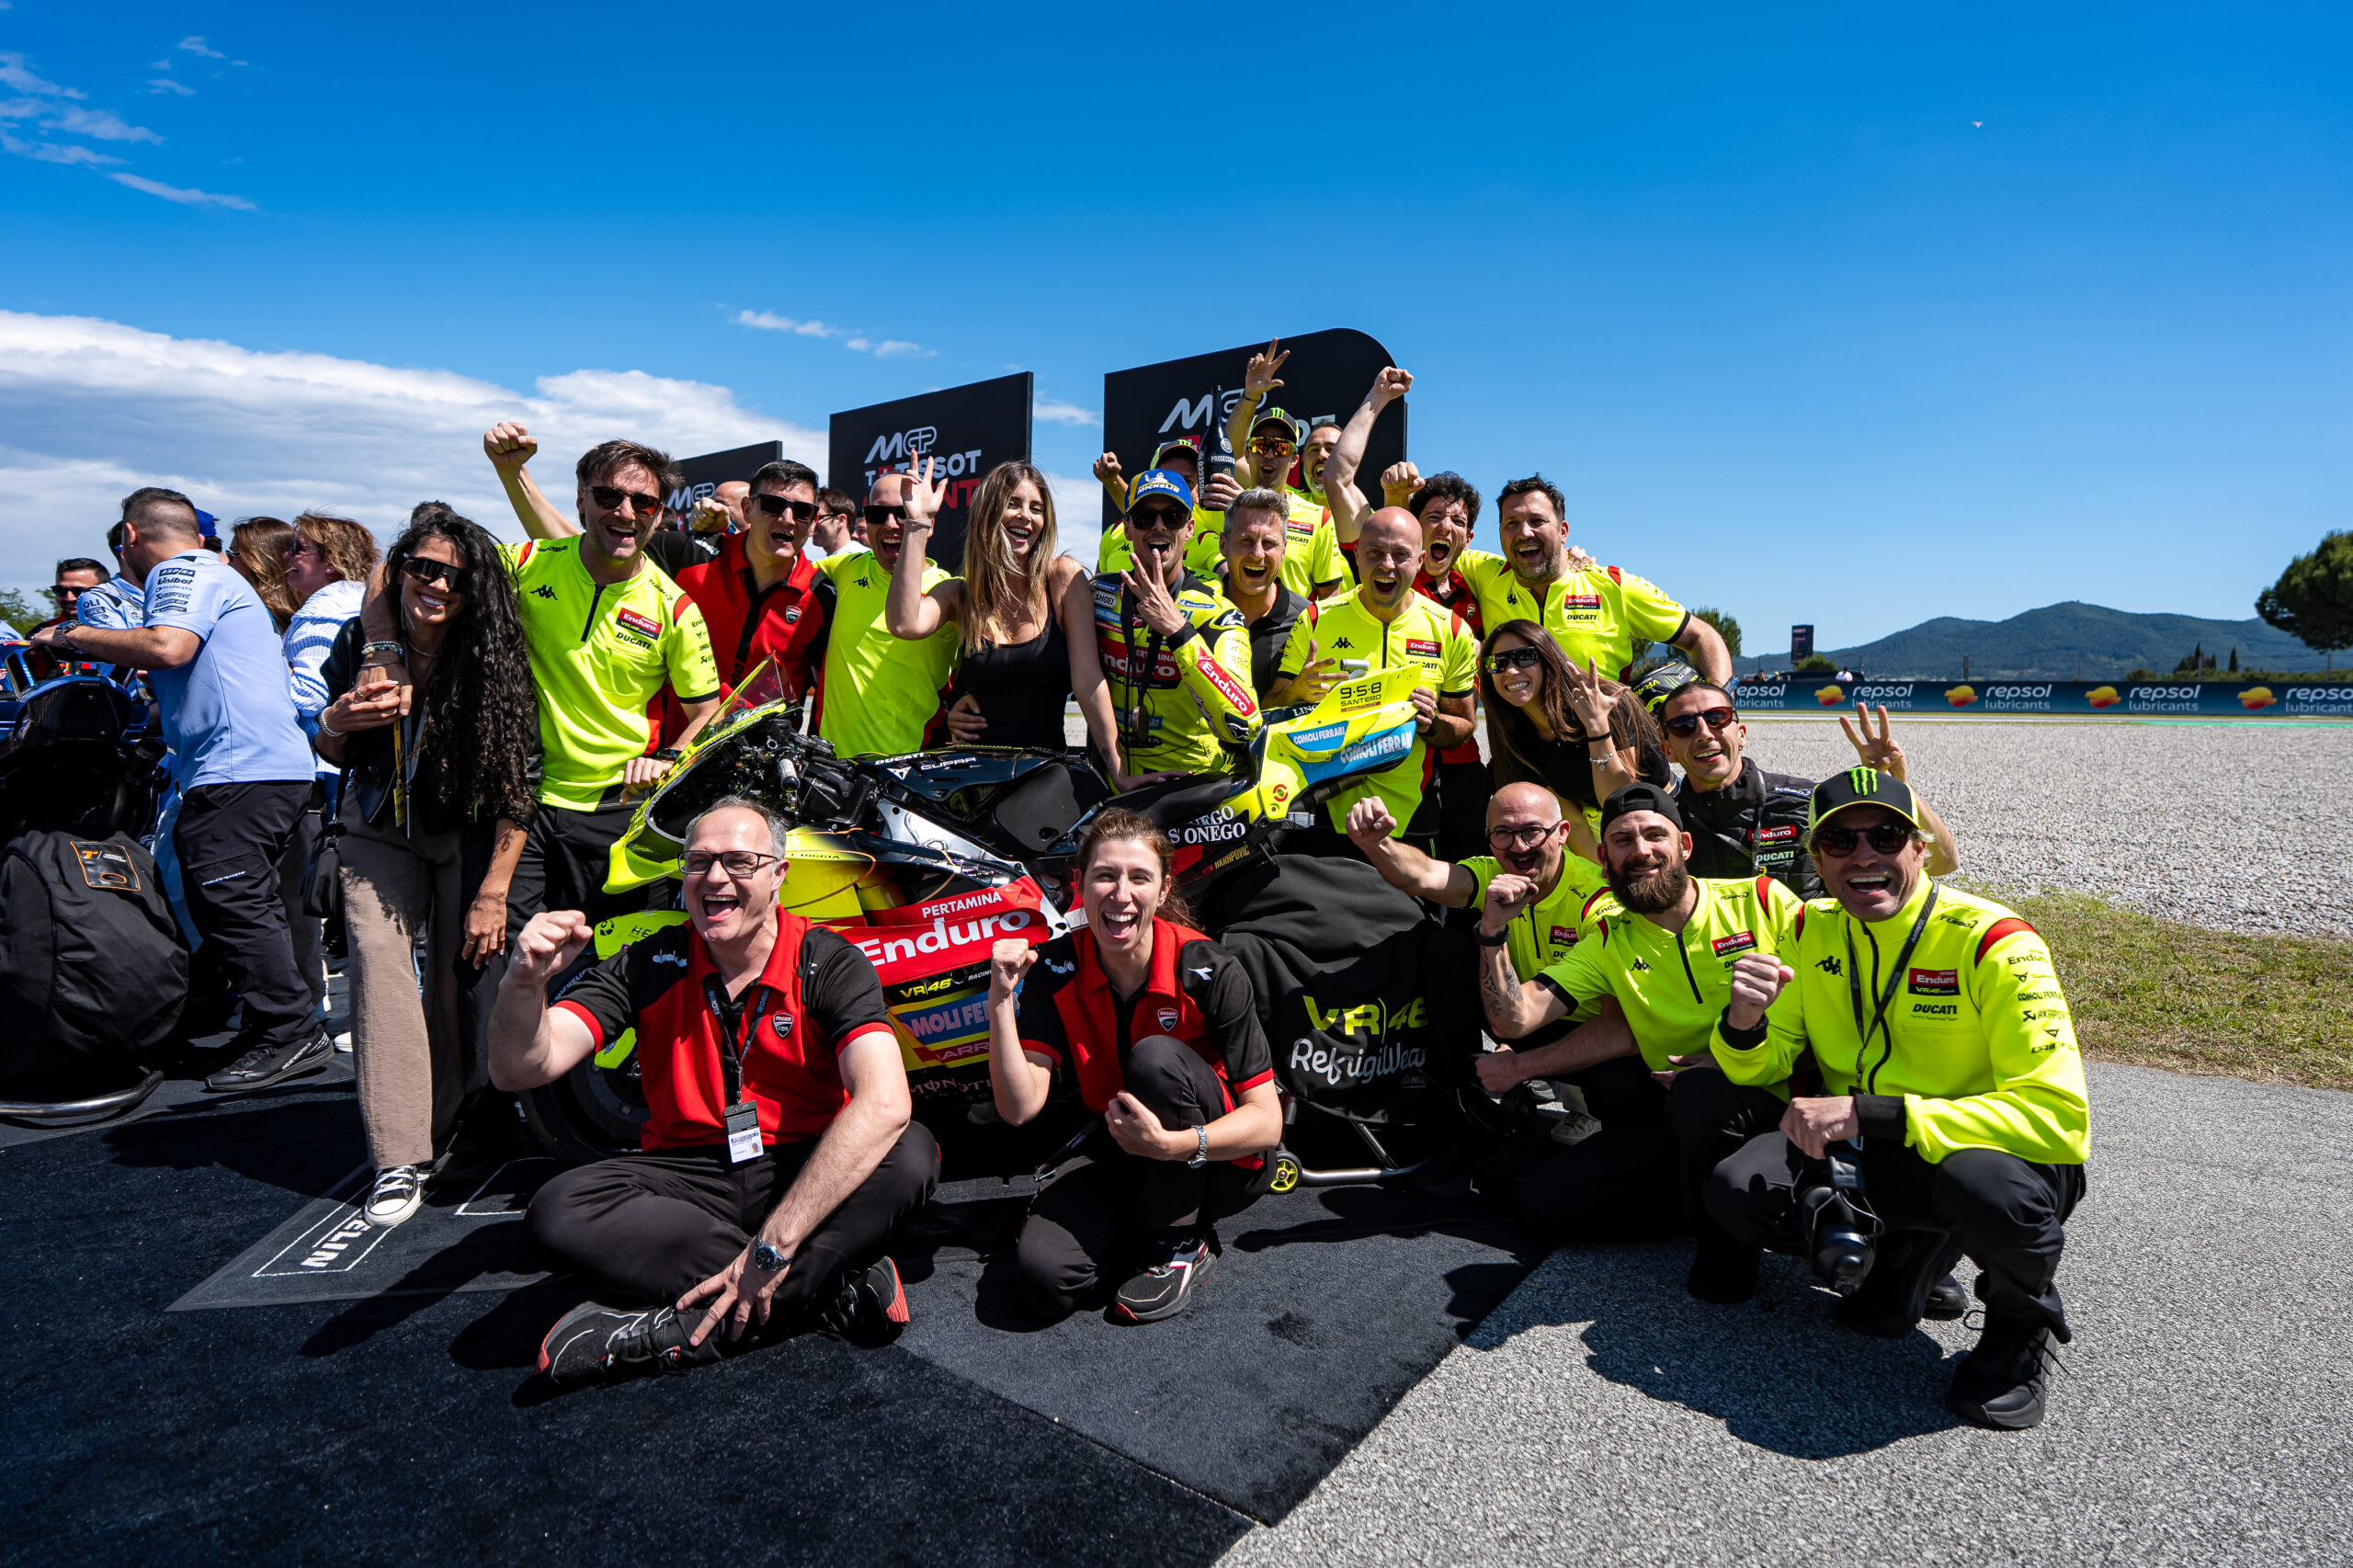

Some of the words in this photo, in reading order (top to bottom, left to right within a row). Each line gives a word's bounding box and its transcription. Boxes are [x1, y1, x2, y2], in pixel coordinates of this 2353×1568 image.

[894, 449, 982, 479] TSSOT
[1137, 483, 1179, 495] MICHELIN
[1287, 535, 1309, 543] DUCATI
[1095, 593, 1114, 606] SHOEI
[623, 613, 656, 631] Enduro
[616, 632, 652, 649] DUCATI
[1410, 642, 1437, 651] Enduro
[1201, 661, 1247, 713] Enduro
[1228, 679, 1251, 705] PERTAMINA
[1736, 684, 1786, 699] epsol
[1852, 684, 1914, 699] repsol
[1985, 685, 2052, 701] repsol
[2129, 685, 2201, 699] repsol
[1341, 695, 1381, 707] SANTERO
[2286, 687, 2353, 702] repso
[1736, 699, 1784, 708] bricants
[1985, 699, 2051, 710] lubricants
[2129, 700, 2199, 711] lubricants
[2285, 701, 2353, 713] lubricant
[1293, 730, 1319, 745] COMOLI
[1318, 726, 1346, 741] FERRARI
[1339, 739, 1379, 764] COMOLI
[1378, 731, 1413, 756] FERRARI
[875, 752, 925, 766] DUCATI
[921, 757, 976, 770] CUPRA
[1756, 850, 1794, 862] DUCATI
[922, 892, 1002, 918] PERTAMINA
[1596, 903, 1621, 916] Endur
[854, 911, 1030, 967] Enduro
[1554, 929, 1577, 938] Endur
[1717, 936, 1750, 949] Enduro
[1915, 974, 1955, 984] Enduro
[1912, 1004, 1958, 1015] DUCATI
[903, 1007, 961, 1038] MOLI
